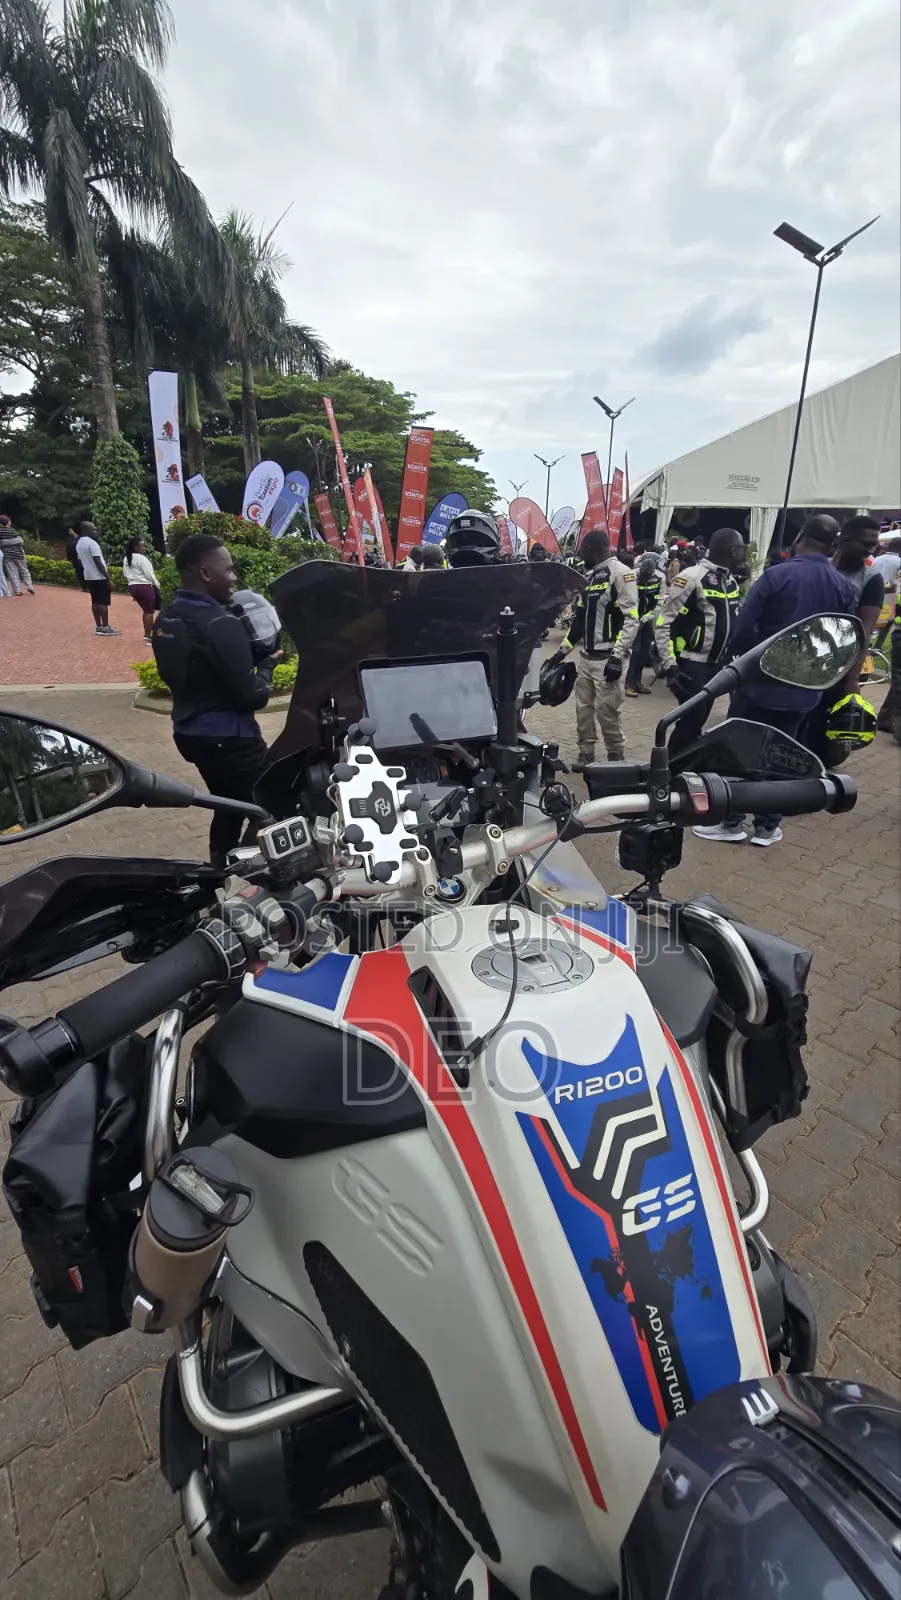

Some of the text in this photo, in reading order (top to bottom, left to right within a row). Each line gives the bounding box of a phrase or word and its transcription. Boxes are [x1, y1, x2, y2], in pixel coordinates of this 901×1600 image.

[441, 504, 460, 516] LATO
[429, 522, 446, 532] LATO
[554, 1065, 644, 1105] R1200
[622, 1172, 697, 1237] GS
